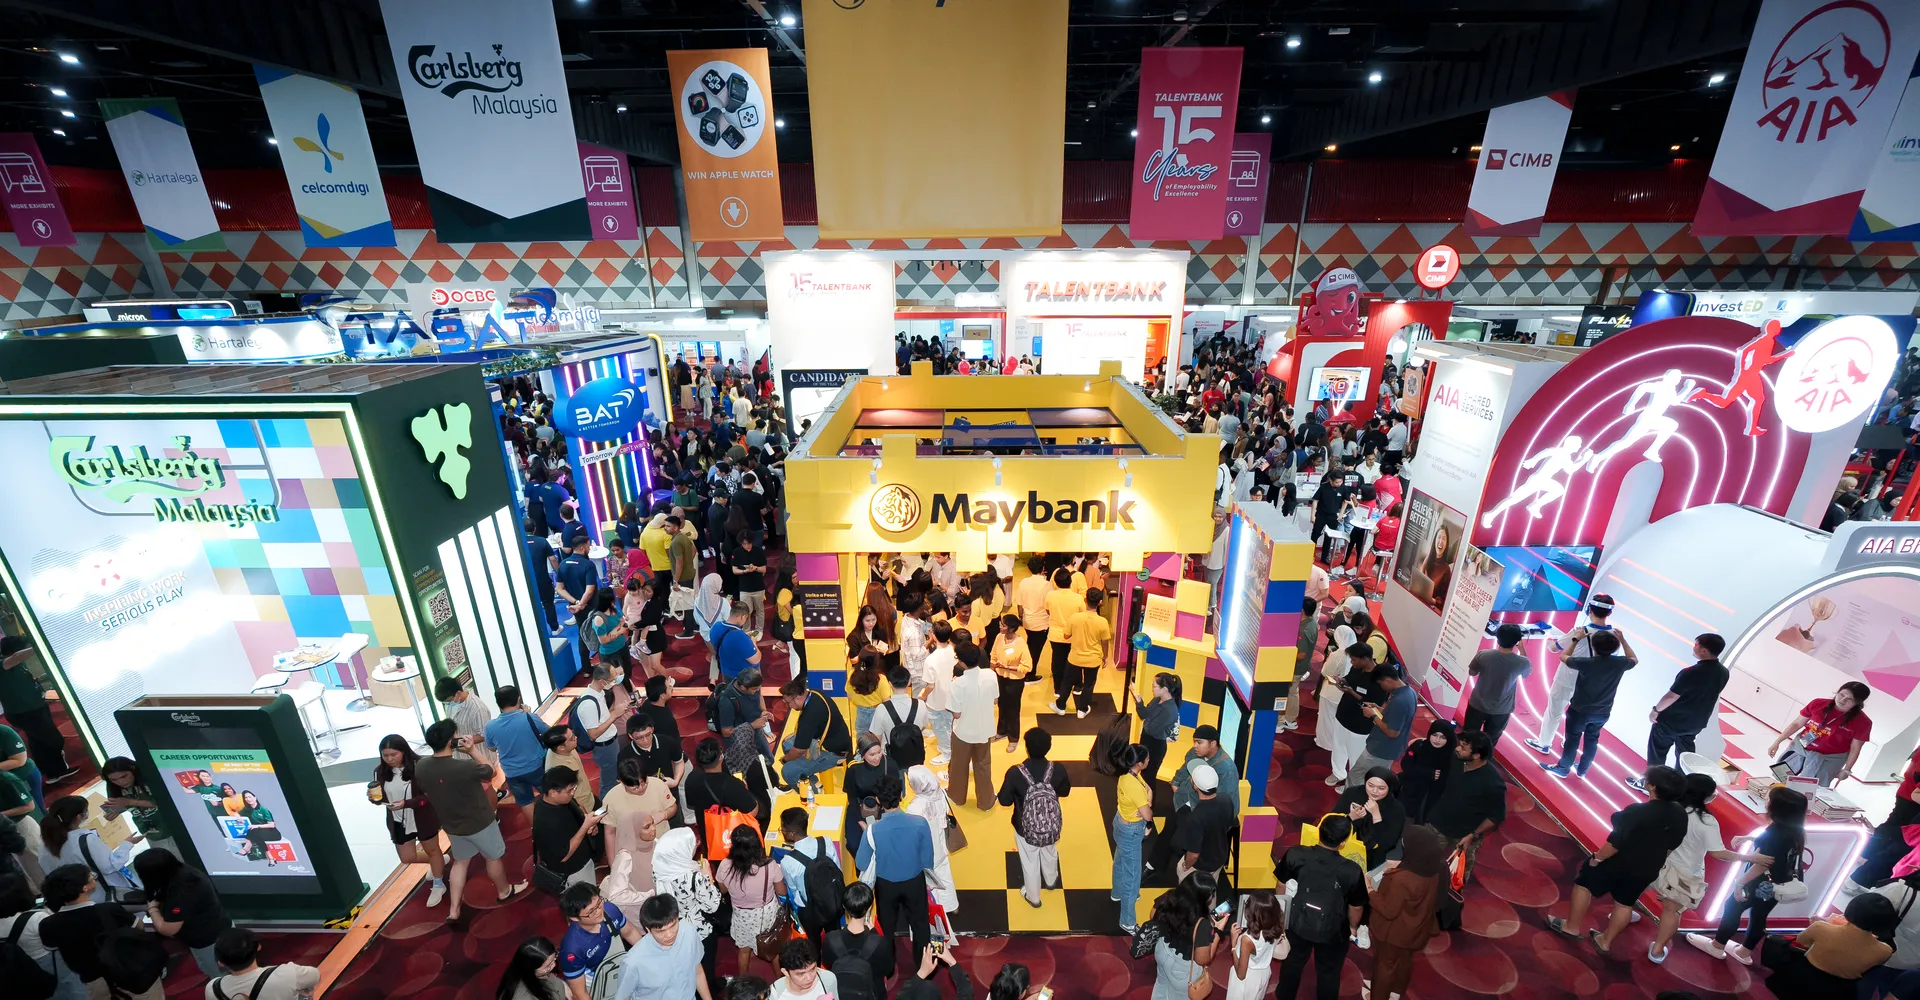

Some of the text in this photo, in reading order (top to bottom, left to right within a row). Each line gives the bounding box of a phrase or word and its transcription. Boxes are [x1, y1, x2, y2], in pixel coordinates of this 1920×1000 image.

[407, 43, 524, 99] Carlsberg
[1155, 92, 1224, 102] TALENTBANK
[472, 94, 558, 119] Malaysia
[1756, 95, 1858, 144] AIA
[1153, 105, 1223, 167] 15
[1509, 152, 1553, 168] CIMB
[147, 171, 199, 187] Hartalega
[687, 169, 774, 180] WIN APPLE WATCH
[1142, 146, 1219, 201] Years
[301, 180, 370, 196] celcomdigi
[1173, 183, 1218, 191] Employability
[10, 202, 56, 210] MORE EXHIBITS
[1337, 273, 1356, 281] CIMB
[1425, 274, 1447, 283] CIMB
[451, 289, 497, 303] OCBC
[812, 283, 872, 291] TALENTBANK
[1024, 280, 1168, 303] TALENTBANK
[1695, 300, 1764, 313] investED
[431, 311, 537, 354] BAT
[209, 336, 263, 350] Hartaleg
[1433, 383, 1460, 410] AIA
[1794, 387, 1853, 414] AIA
[575, 401, 624, 426] BAT
[581, 451, 614, 464] Tomorrow
[48, 435, 227, 503] Carlsberg
[152, 497, 280, 529] Malaysia
[929, 490, 1136, 533] Maybank
[1409, 510, 1429, 530] BETTER
[1411, 499, 1440, 523] BELIEVE IN
[1859, 537, 1896, 554] AIA
[84, 570, 188, 623] INSPIRING WORK
[1455, 588, 1465, 600] WITH
[1464, 595, 1472, 605] AIA
[1457, 580, 1485, 607] OPPORTUNITIES
[1476, 586, 1493, 603] CAREER
[101, 585, 185, 632] SERIOUS PLAY
[170, 712, 201, 723] Carlsberg
